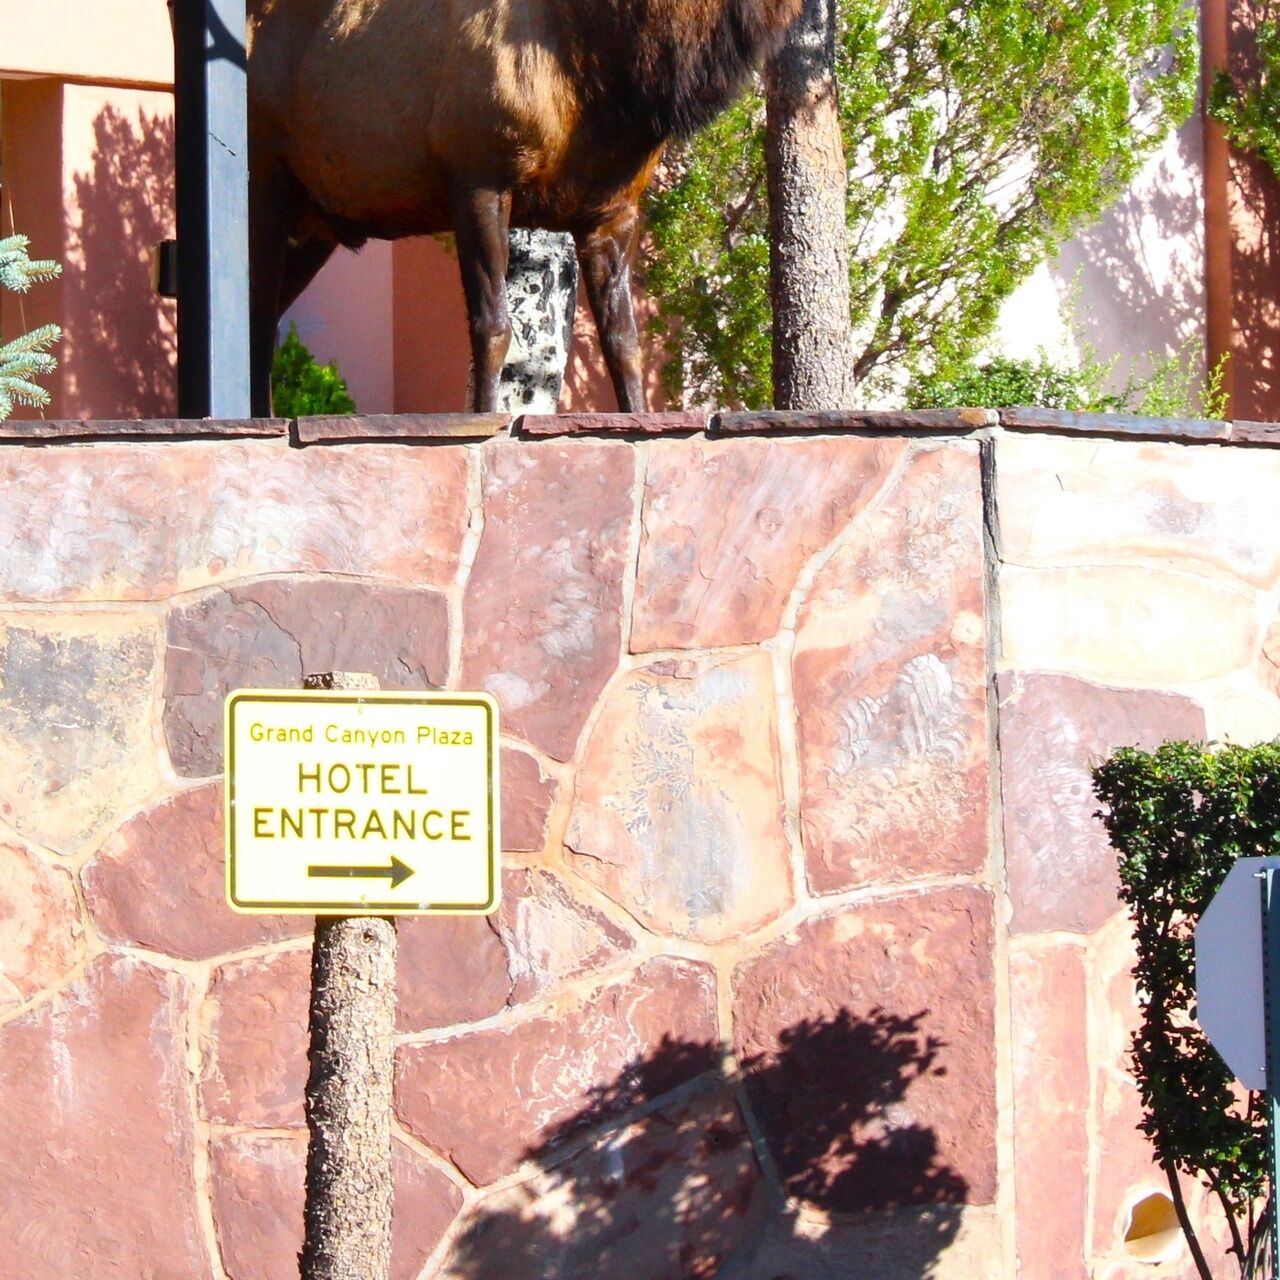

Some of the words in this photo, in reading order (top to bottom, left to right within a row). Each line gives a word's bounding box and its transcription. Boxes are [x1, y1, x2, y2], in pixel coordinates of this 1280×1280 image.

[250, 723, 313, 743] Grand
[325, 724, 405, 748] Canyon
[417, 726, 473, 745] Plaza
[298, 762, 428, 795] HOTEL
[253, 807, 472, 841] ENTRANCE
